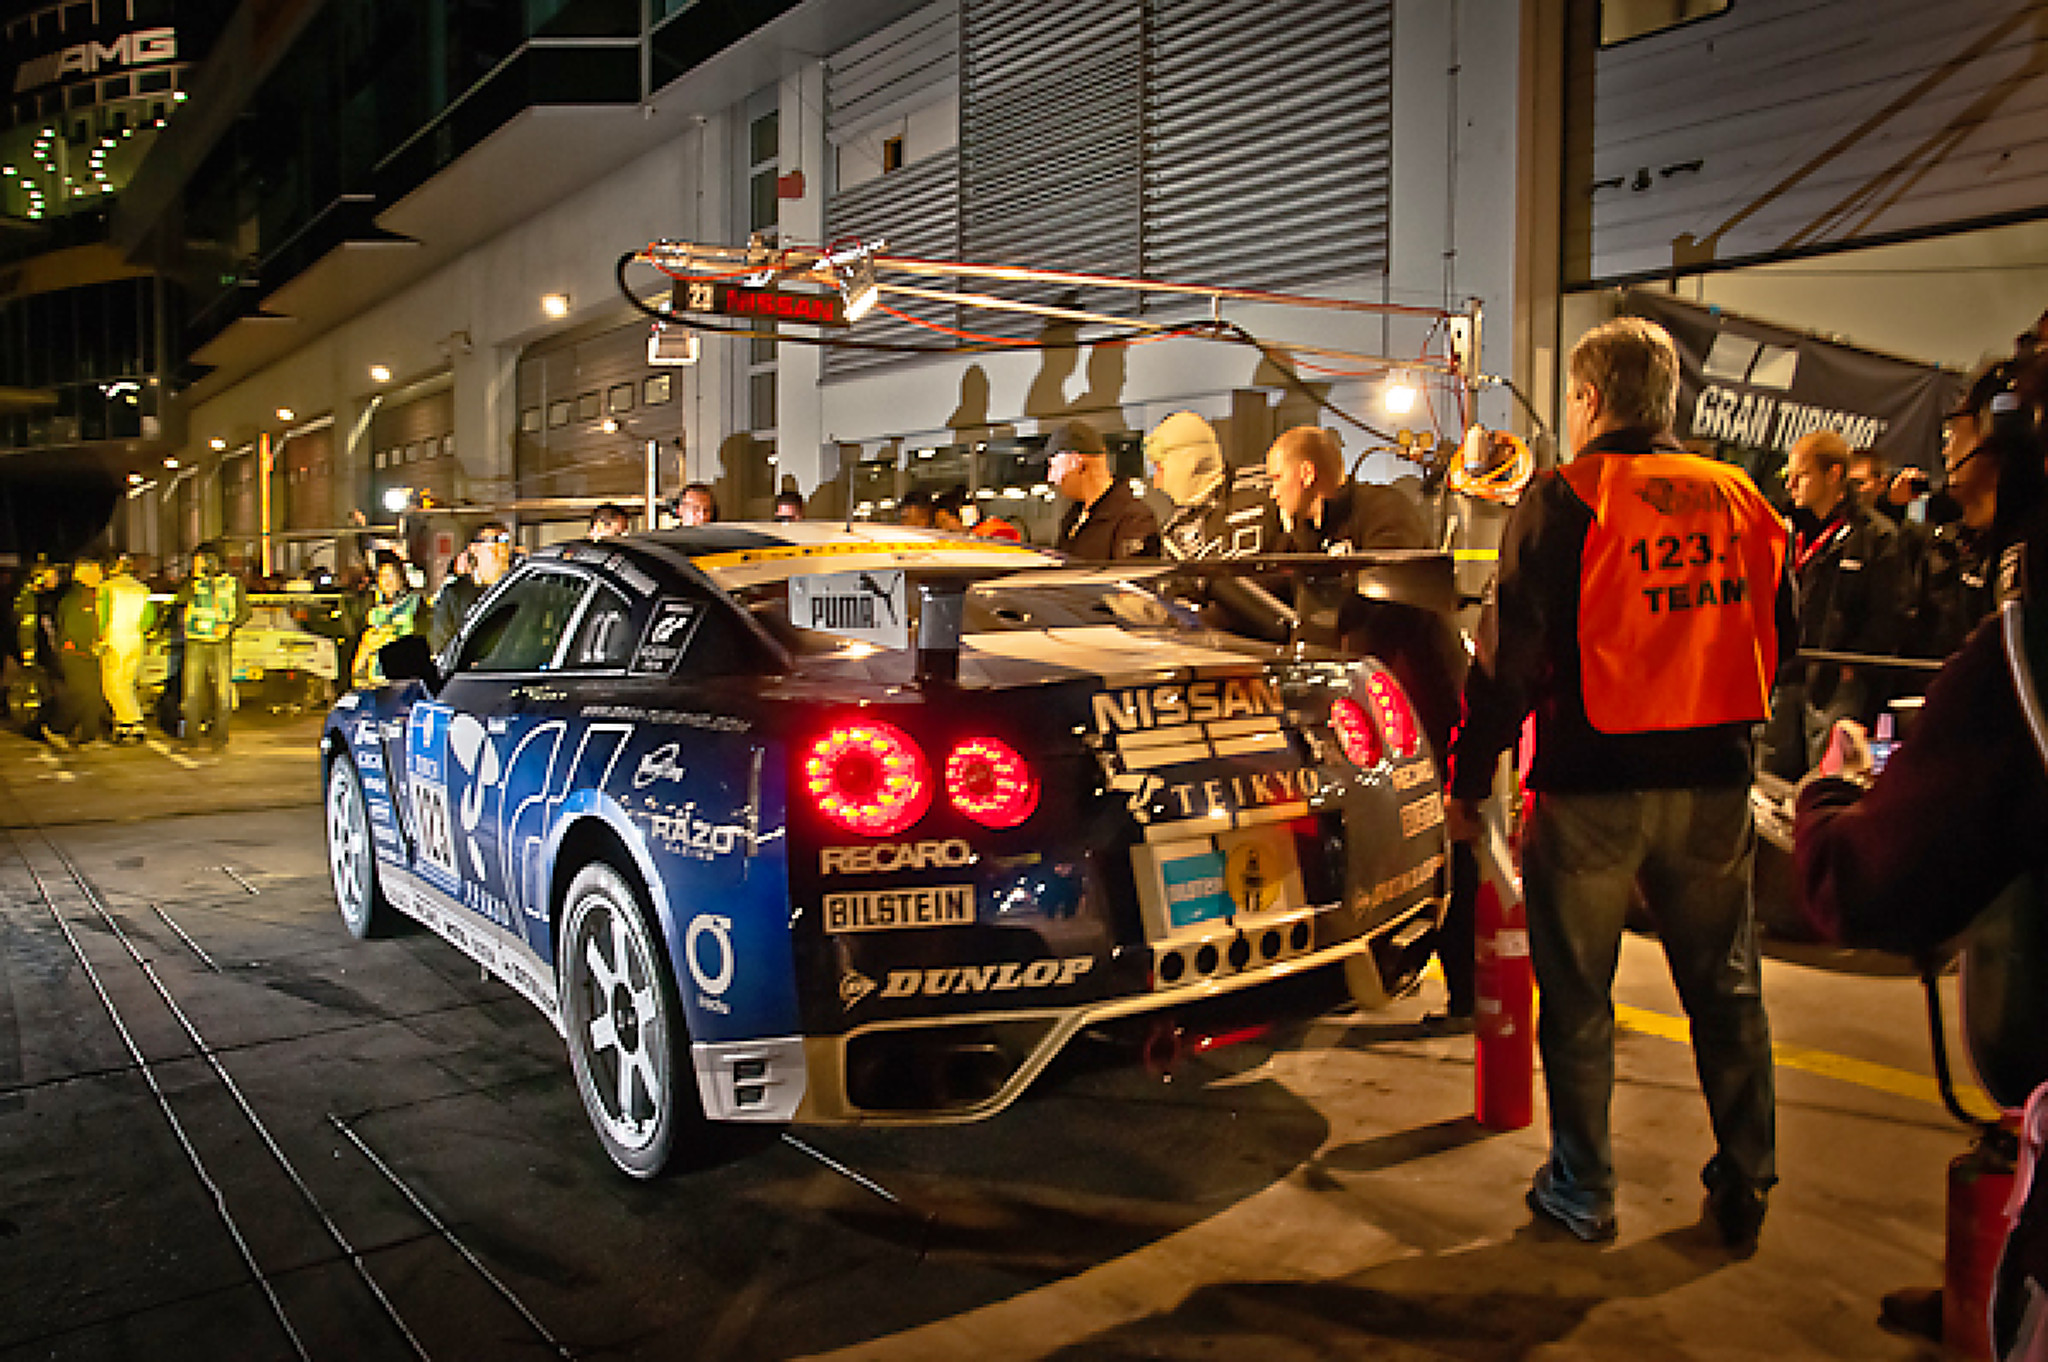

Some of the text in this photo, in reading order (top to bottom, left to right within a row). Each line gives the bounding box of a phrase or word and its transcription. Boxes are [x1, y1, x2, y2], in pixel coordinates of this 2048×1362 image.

[55, 27, 178, 79] AMG
[726, 288, 834, 322] NISSAN
[1692, 385, 1775, 448] GRAN
[1641, 575, 1749, 613] TEAM
[1091, 677, 1285, 735] NISSAN
[1169, 766, 1320, 816] TEIKYO
[820, 838, 971, 876] RECARO
[827, 889, 966, 929] BILSTEIN
[879, 955, 1096, 999] DUNLOP
